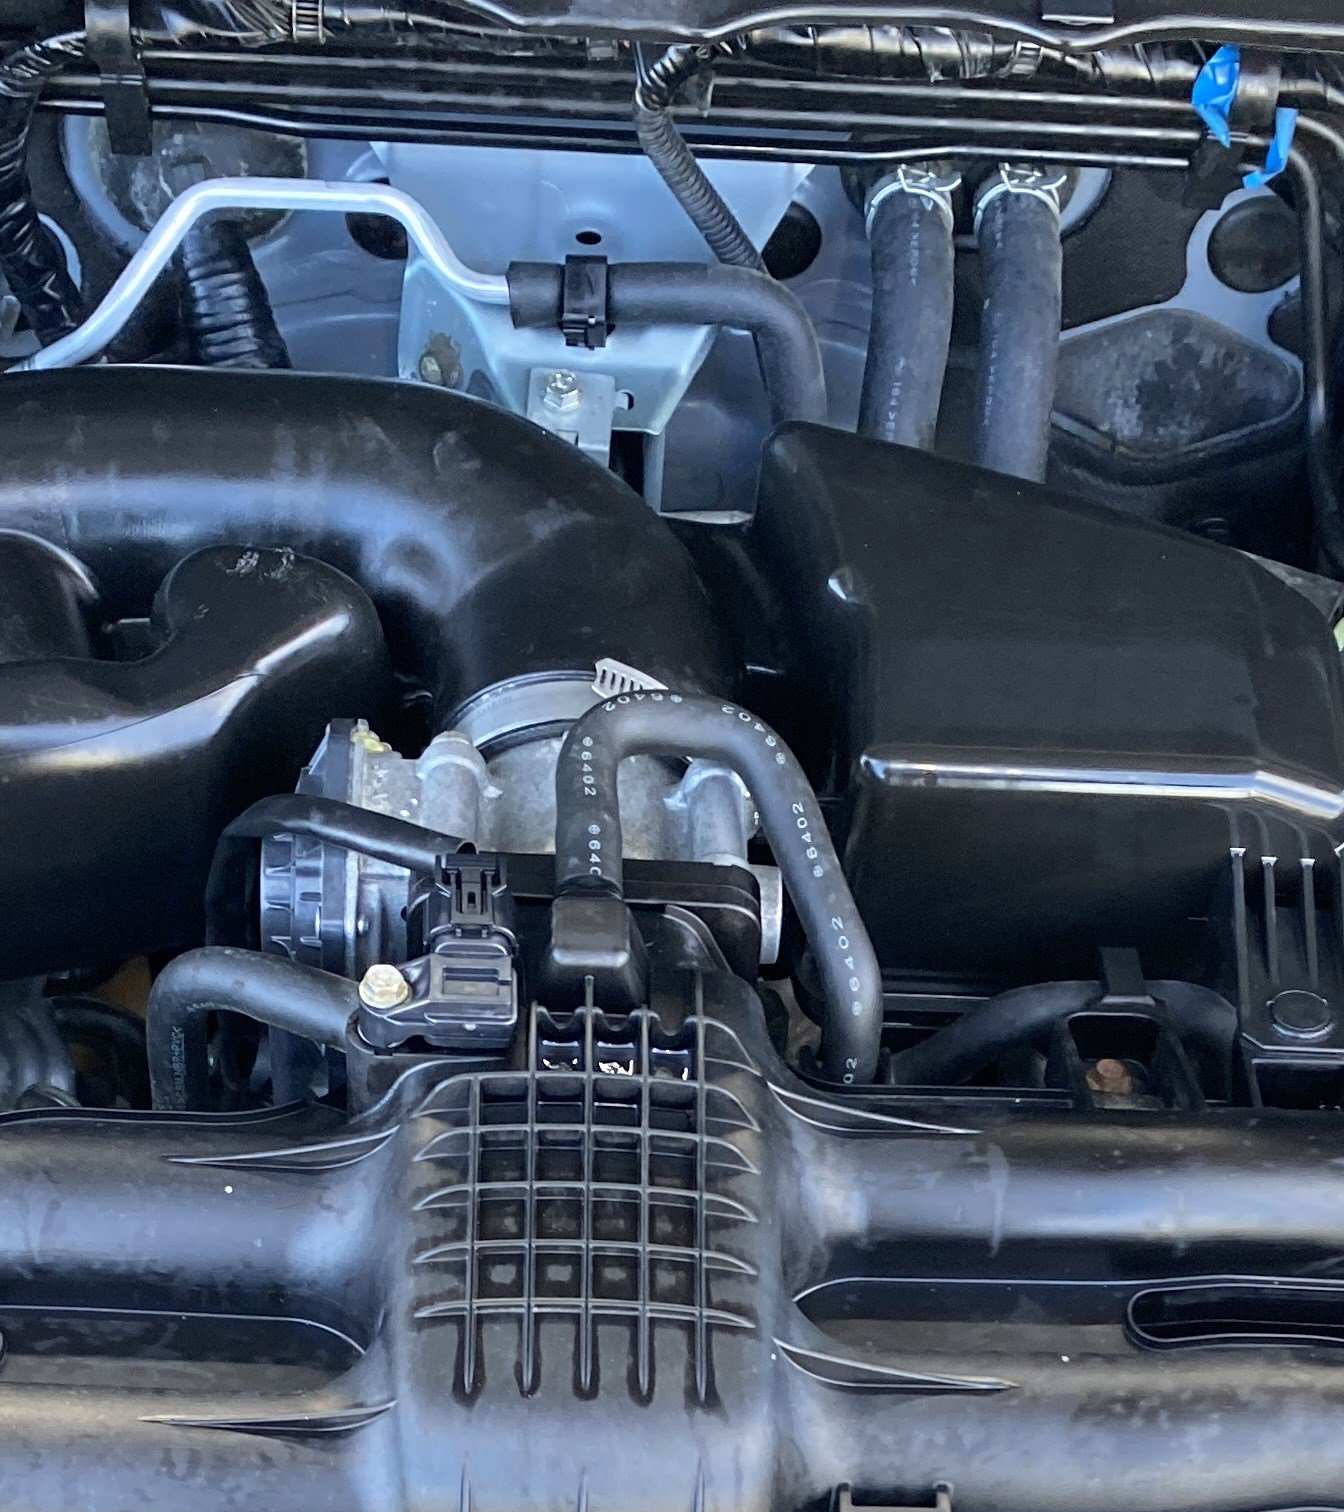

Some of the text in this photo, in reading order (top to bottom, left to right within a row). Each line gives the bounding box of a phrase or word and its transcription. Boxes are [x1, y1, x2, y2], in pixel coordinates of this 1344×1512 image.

[603, 692, 664, 712] 6402
[721, 704, 777, 748] 6402
[581, 751, 597, 796] 6402
[792, 801, 818, 860] 6402
[588, 840, 602, 876] 640
